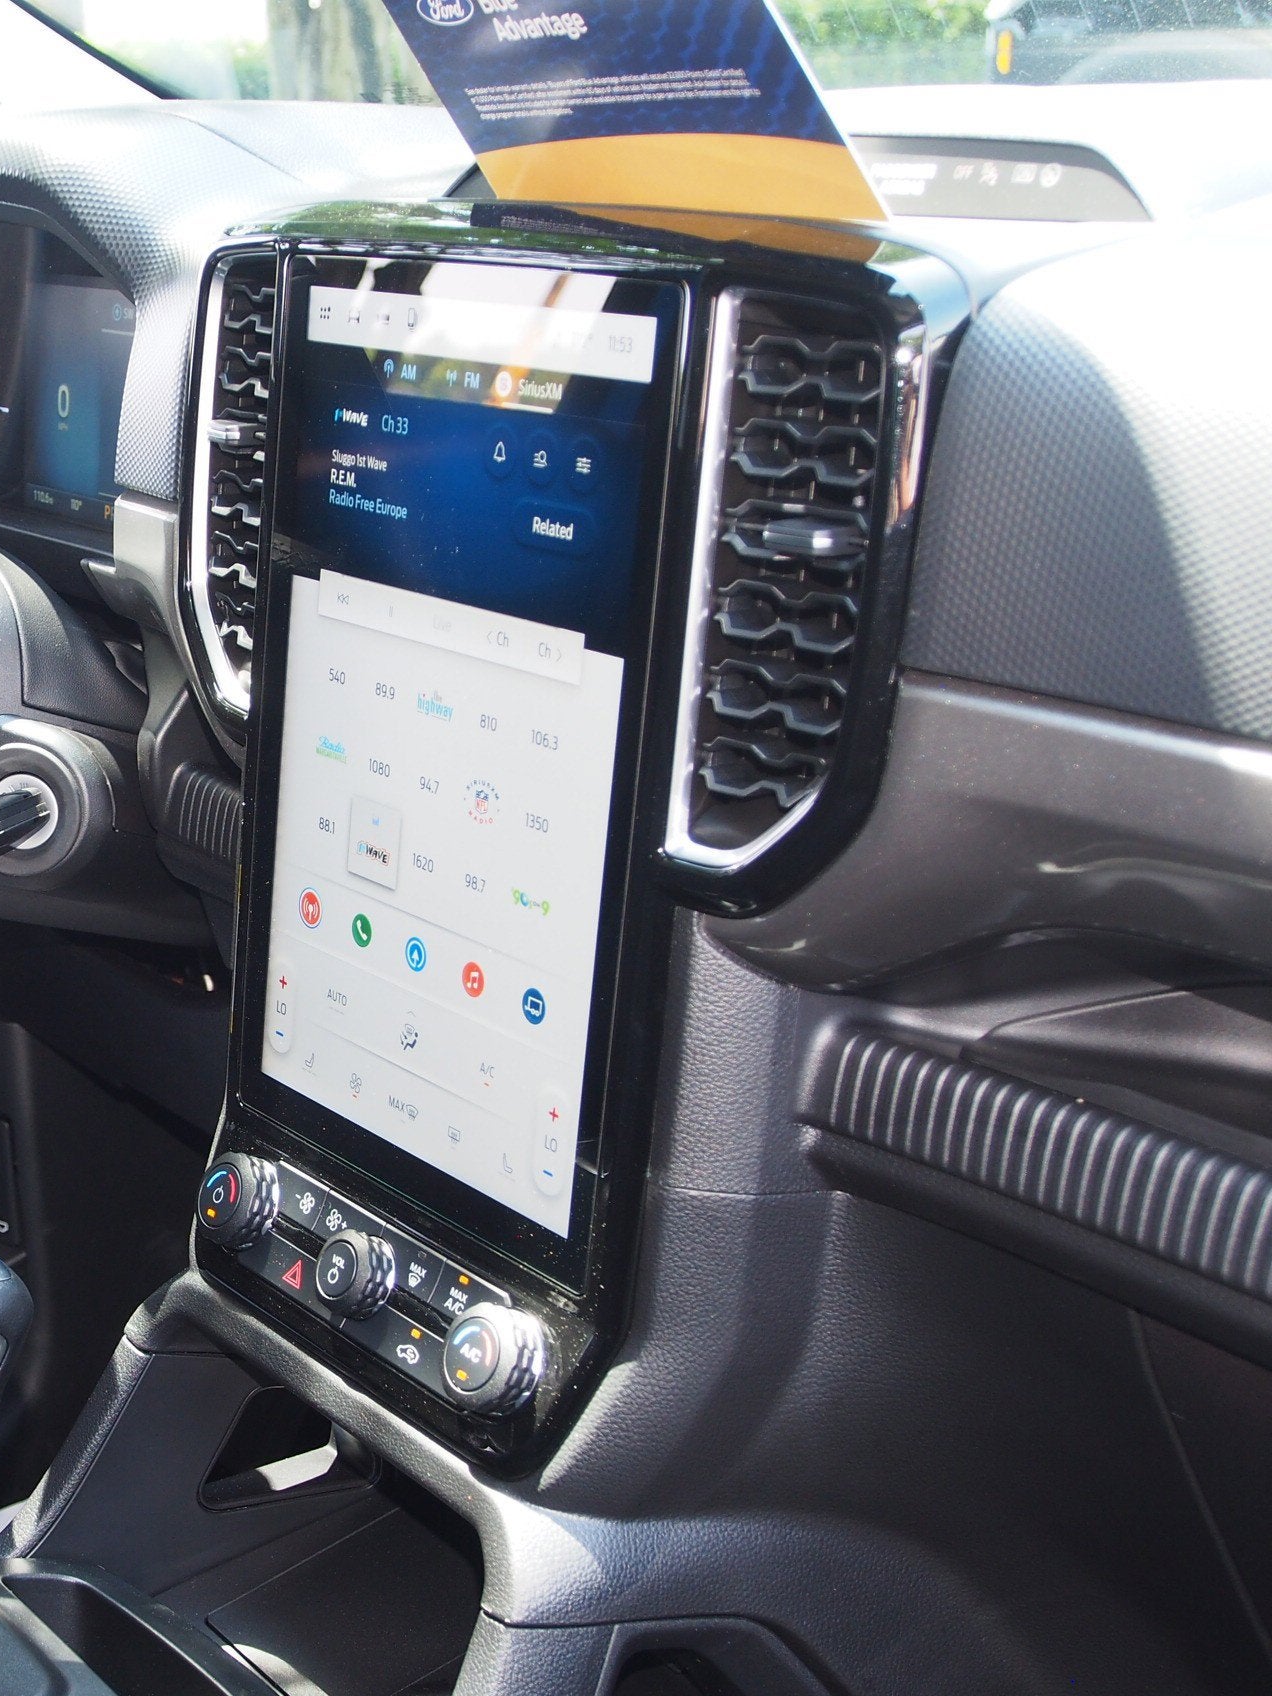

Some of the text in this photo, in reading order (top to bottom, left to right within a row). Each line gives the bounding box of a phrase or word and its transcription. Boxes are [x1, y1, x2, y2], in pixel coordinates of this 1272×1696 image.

[492, 12, 588, 42] Advantage
[609, 334, 634, 354] 11:53
[401, 363, 417, 381] AM
[464, 371, 480, 389] FM
[518, 379, 564, 401] SiriusXM
[381, 414, 409, 435] Ch 33
[332, 449, 388, 471] Sluggo 1st Wave
[330, 468, 357, 488] R.E.M.
[329, 488, 408, 520] Radio Free Europe
[532, 516, 574, 541] Related
[496, 631, 509, 648] Ch
[538, 642, 552, 660] Ch
[328, 667, 346, 685] 540
[375, 682, 395, 700] 89.9
[417, 692, 454, 723] highway
[479, 714, 498, 732] 810
[530, 729, 559, 751] 106.3
[368, 758, 391, 778] 1080
[419, 776, 440, 795] 94.7
[318, 816, 335, 835] 88.1
[525, 812, 549, 833] 1350
[411, 853, 434, 873] 1620
[464, 873, 486, 893] 98.7
[327, 988, 348, 1007] AUTO
[276, 1000, 287, 1016] LO
[479, 1062, 495, 1079] A/C
[388, 1095, 405, 1112] MAX
[544, 1134, 558, 1153] LO
[332, 1253, 345, 1270] VOL
[409, 1261, 427, 1279] MAX
[449, 1286, 468, 1304] MAX
[444, 1299, 465, 1316] A/C
[459, 1343, 482, 1364] A/C
